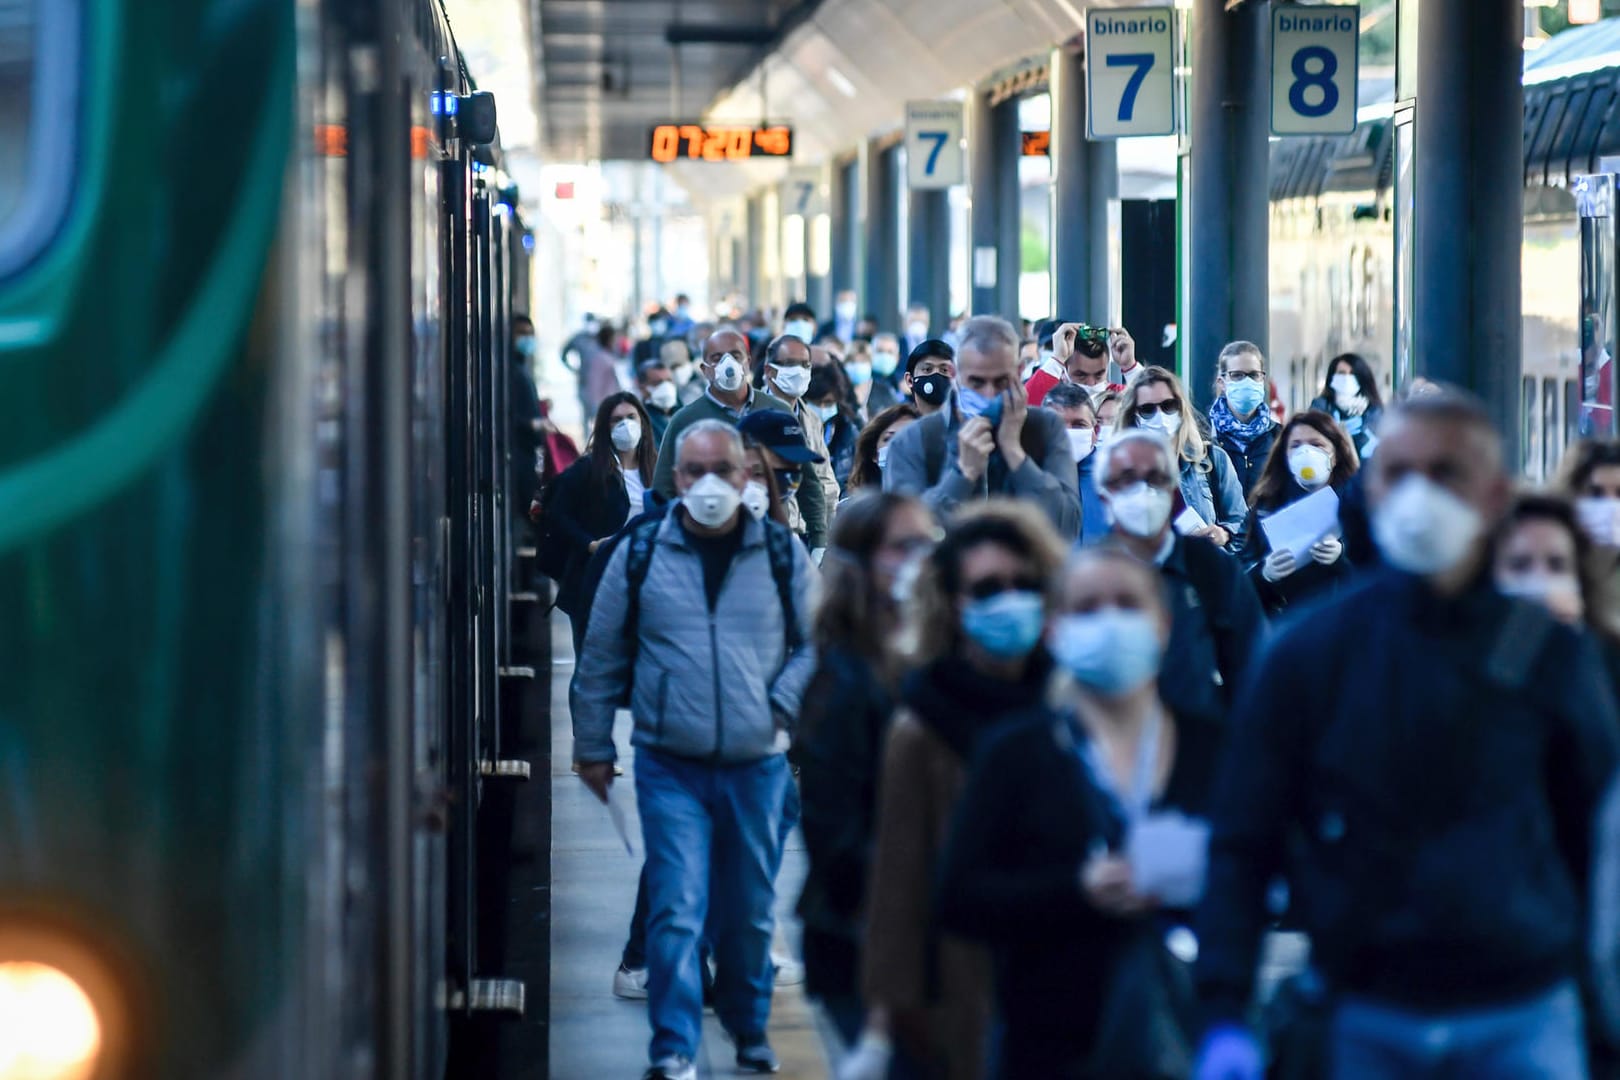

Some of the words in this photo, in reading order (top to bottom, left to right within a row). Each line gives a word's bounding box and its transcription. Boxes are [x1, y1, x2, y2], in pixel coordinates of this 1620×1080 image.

[1095, 16, 1167, 34] binario
[1280, 14, 1352, 32] binario
[1106, 53, 1155, 122] 7
[1288, 46, 1339, 118] 8
[917, 131, 949, 175] 7
[795, 181, 815, 213] 7
